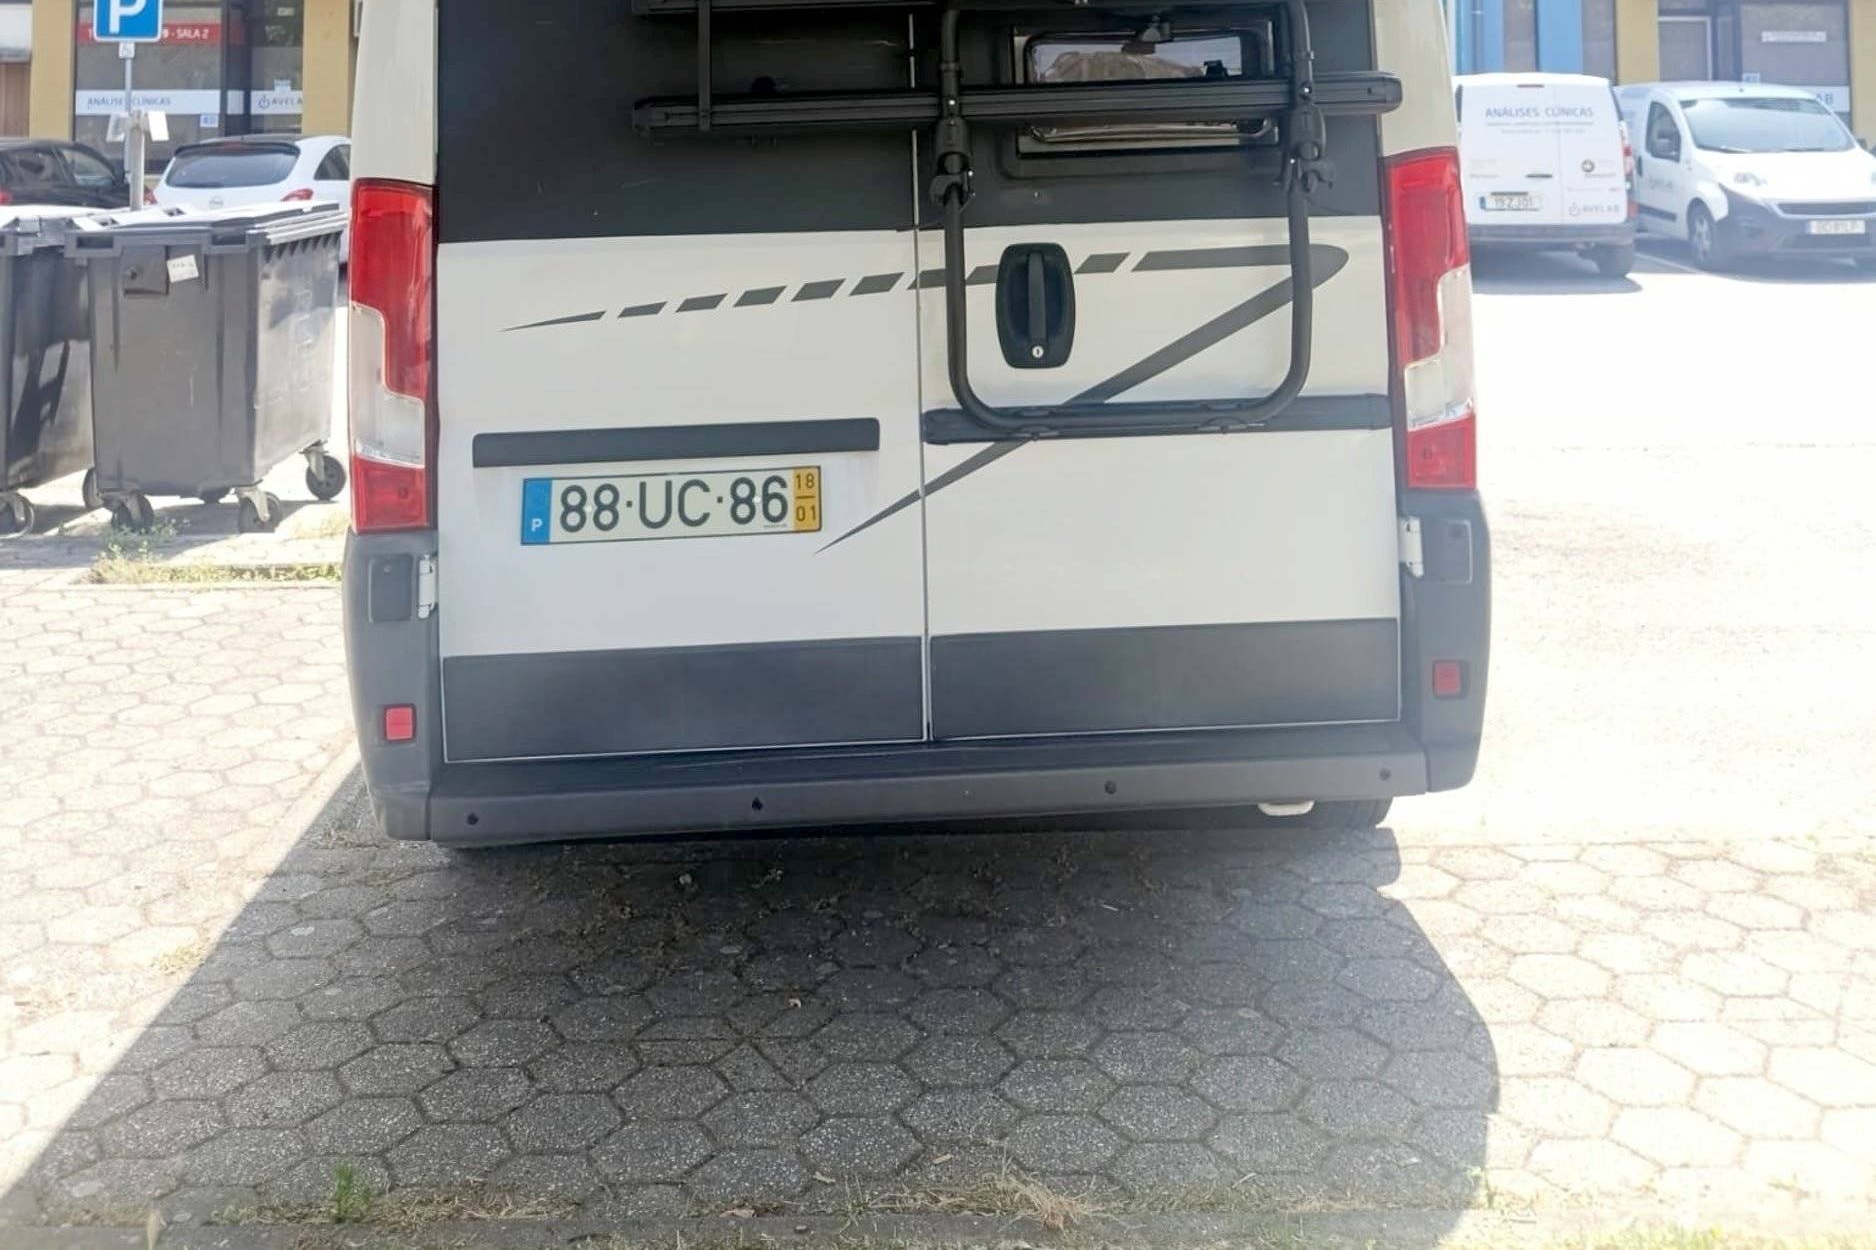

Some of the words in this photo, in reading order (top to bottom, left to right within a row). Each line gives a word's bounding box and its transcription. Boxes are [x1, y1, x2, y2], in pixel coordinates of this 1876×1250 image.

[176, 28, 200, 40] SALA
[88, 96, 131, 106] ANÁLISE
[272, 96, 303, 105] AVELA
[796, 473, 815, 490] 18
[796, 505, 816, 522] 01
[531, 517, 543, 533] P
